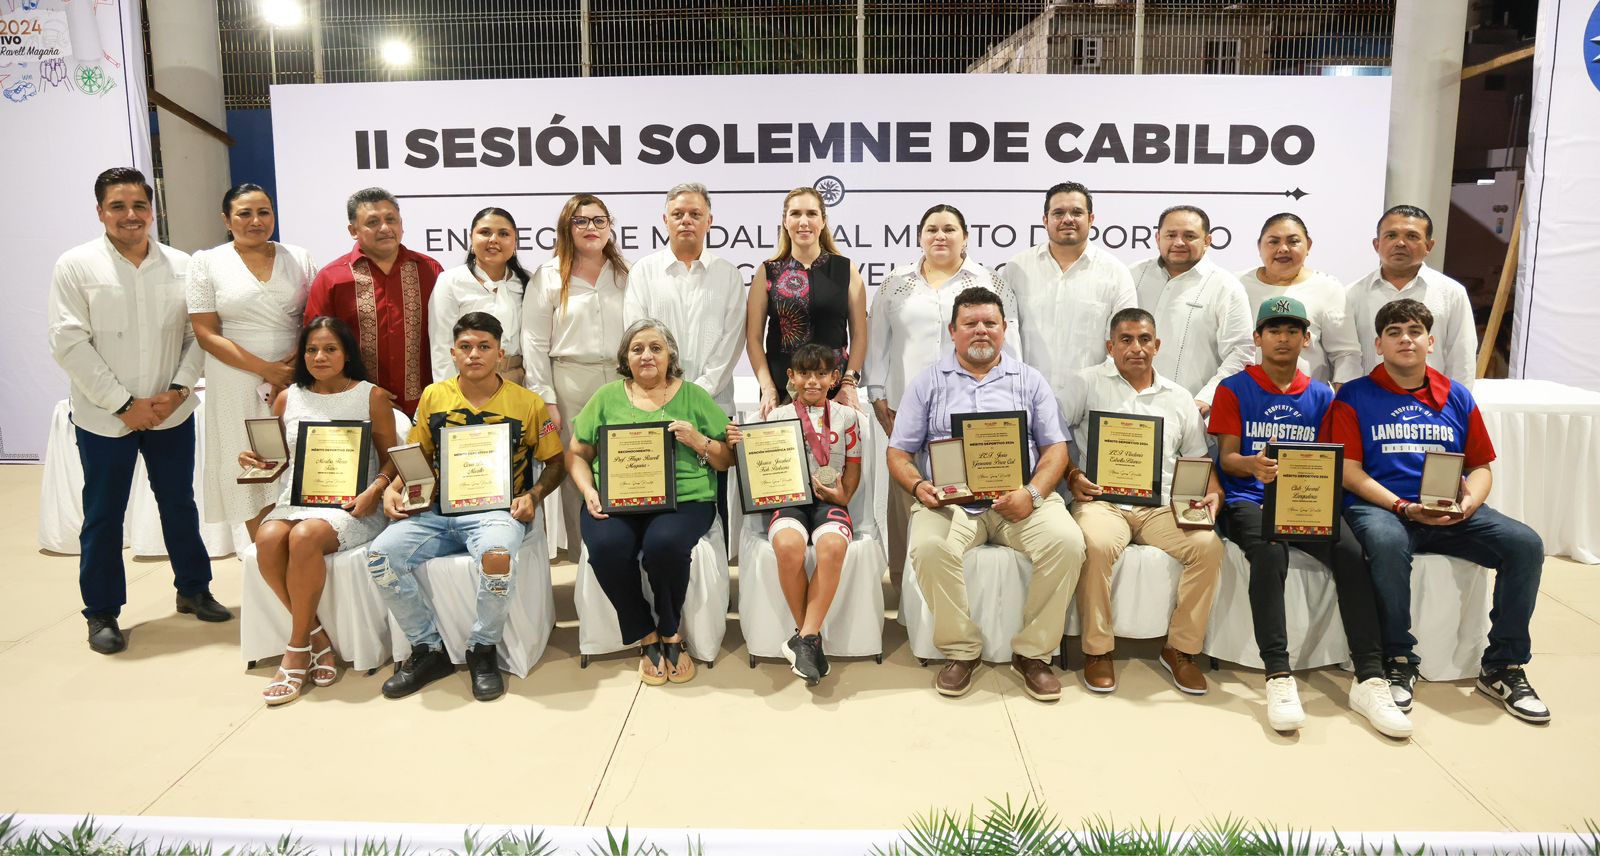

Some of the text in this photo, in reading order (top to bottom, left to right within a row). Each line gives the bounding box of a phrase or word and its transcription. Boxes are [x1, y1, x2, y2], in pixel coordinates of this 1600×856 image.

[27, 46, 59, 60] Magaña
[355, 113, 1315, 170] II SESIÓN SOLEMNE DE CABILDO
[1264, 405, 1302, 418] PROPERTY OF
[1391, 405, 1423, 417] PROPERTY
[1246, 421, 1316, 441] LANGOSTEROS
[1371, 423, 1455, 442] LANGOSTEROS
